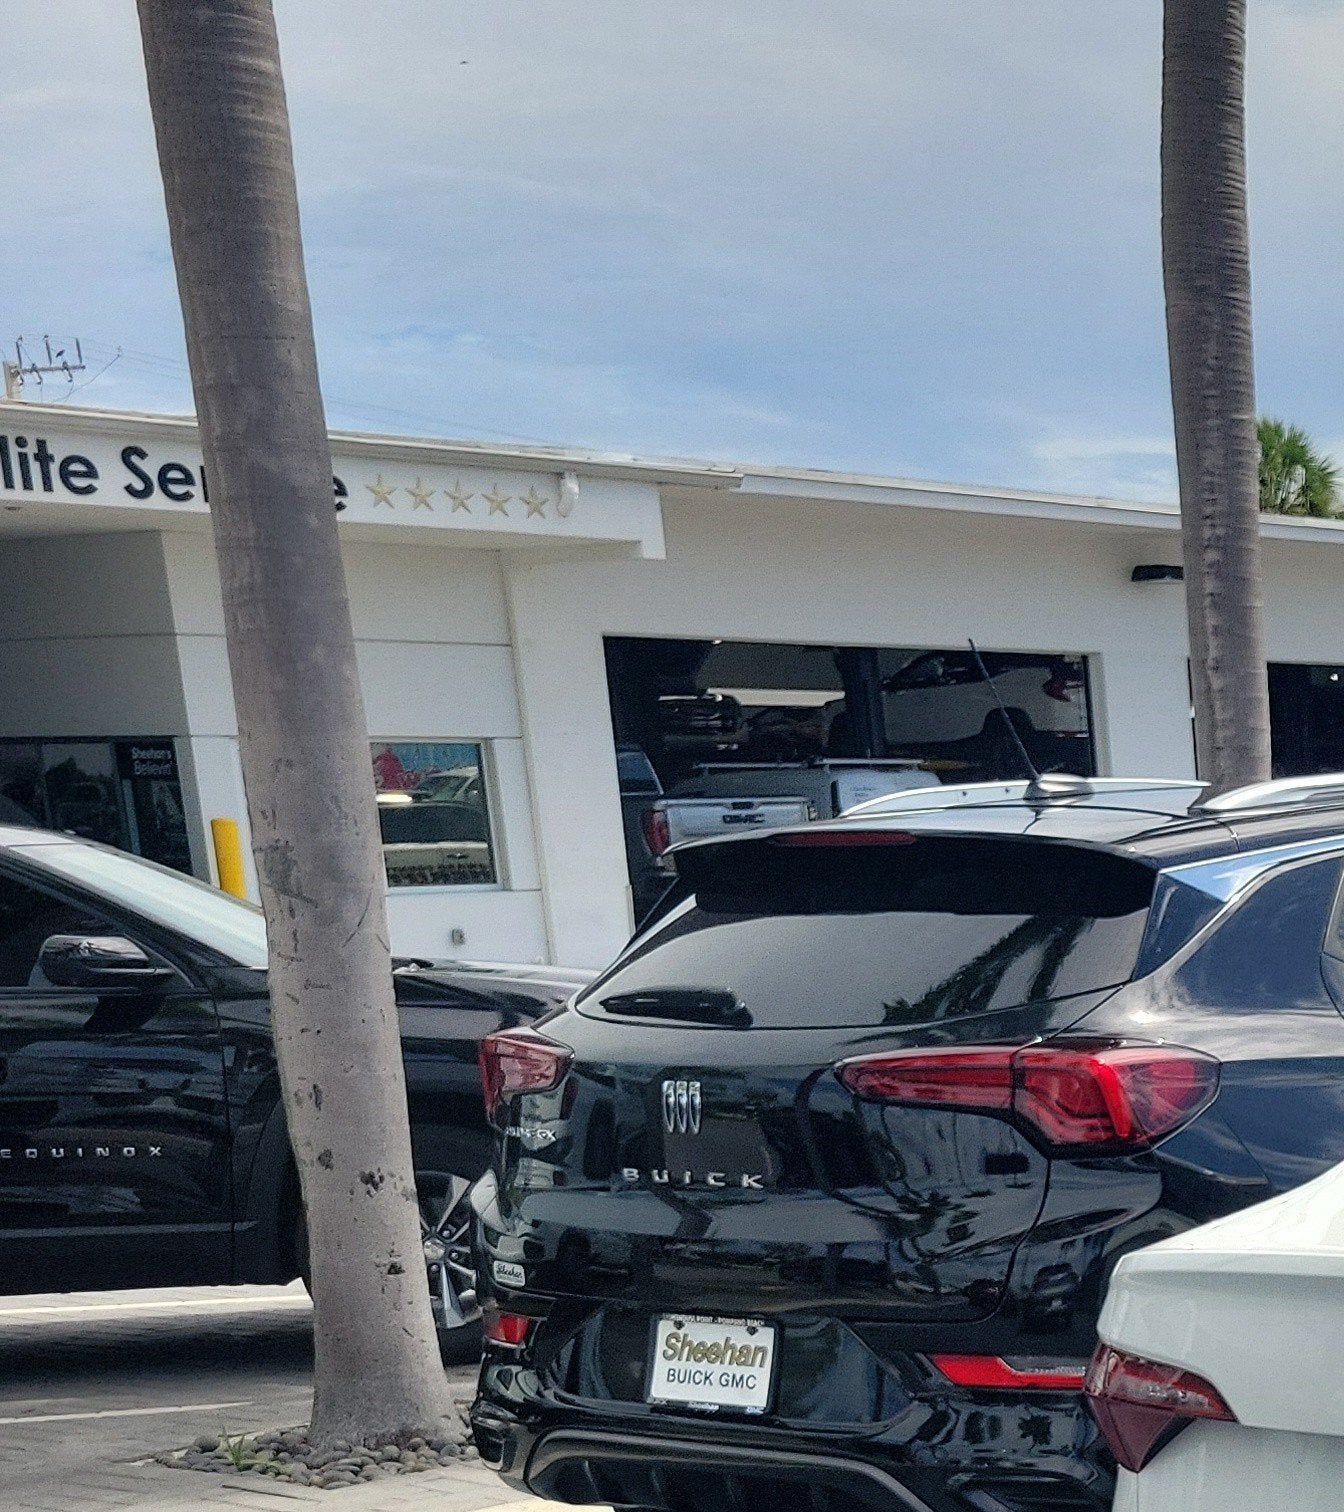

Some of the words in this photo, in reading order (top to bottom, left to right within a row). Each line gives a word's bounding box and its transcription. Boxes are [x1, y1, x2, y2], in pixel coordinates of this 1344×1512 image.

[0, 1146, 162, 1159] EQUINOX
[622, 1167, 764, 1189] BUICK
[662, 1331, 769, 1368] Sheehan
[667, 1367, 714, 1387] BUICK
[719, 1371, 757, 1390] GMC
